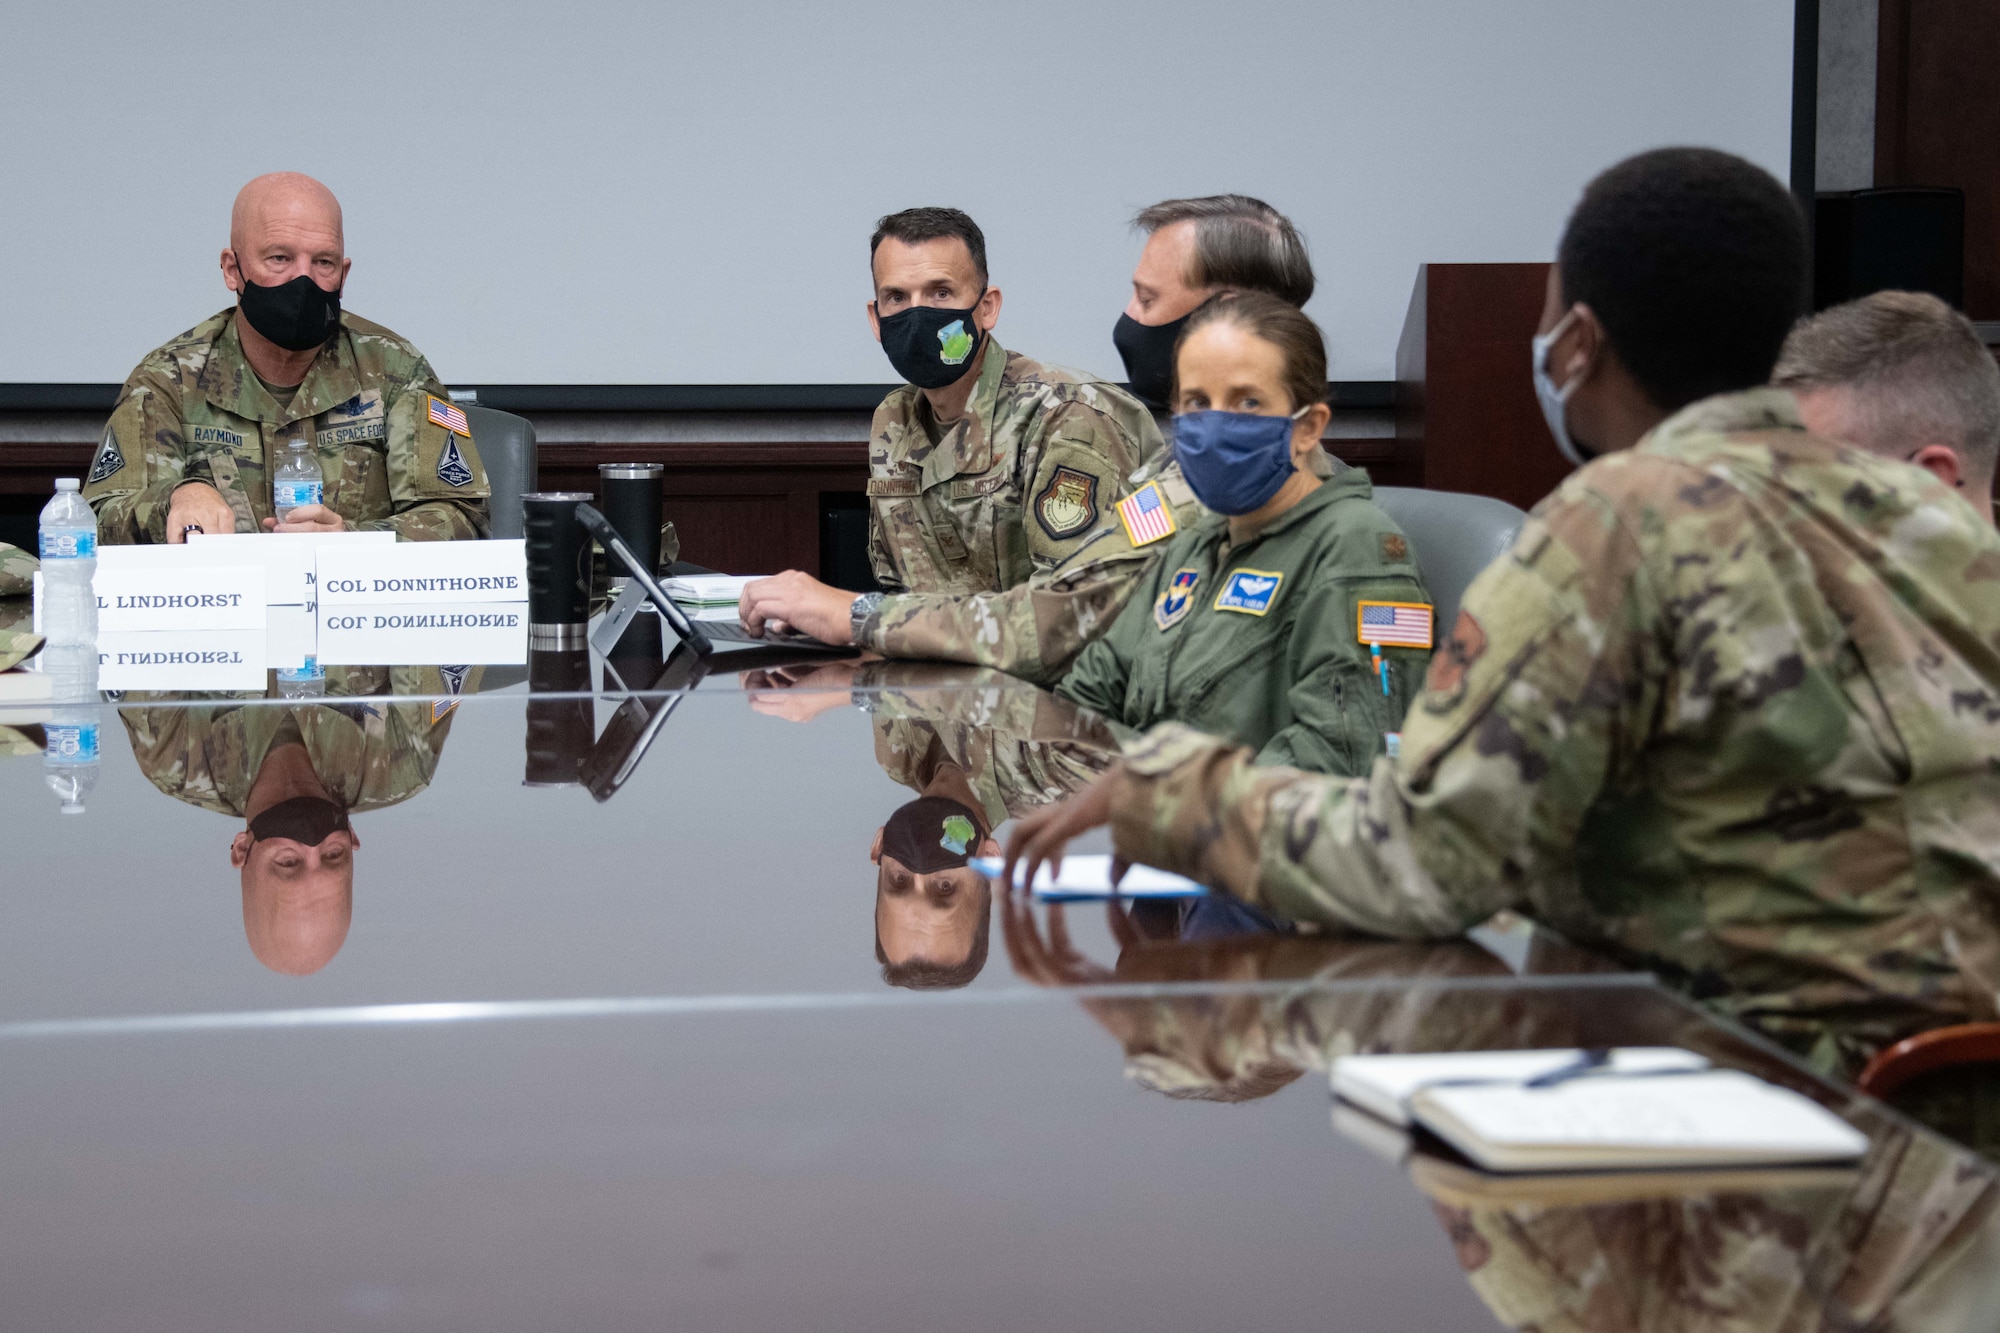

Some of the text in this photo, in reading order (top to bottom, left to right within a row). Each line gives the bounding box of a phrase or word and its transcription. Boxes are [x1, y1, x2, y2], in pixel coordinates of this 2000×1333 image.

[194, 427, 243, 447] RAYMOND
[336, 427, 366, 443] SPACE
[326, 576, 519, 593] COL DONNITHORNE
[116, 593, 242, 609] LINDHORST
